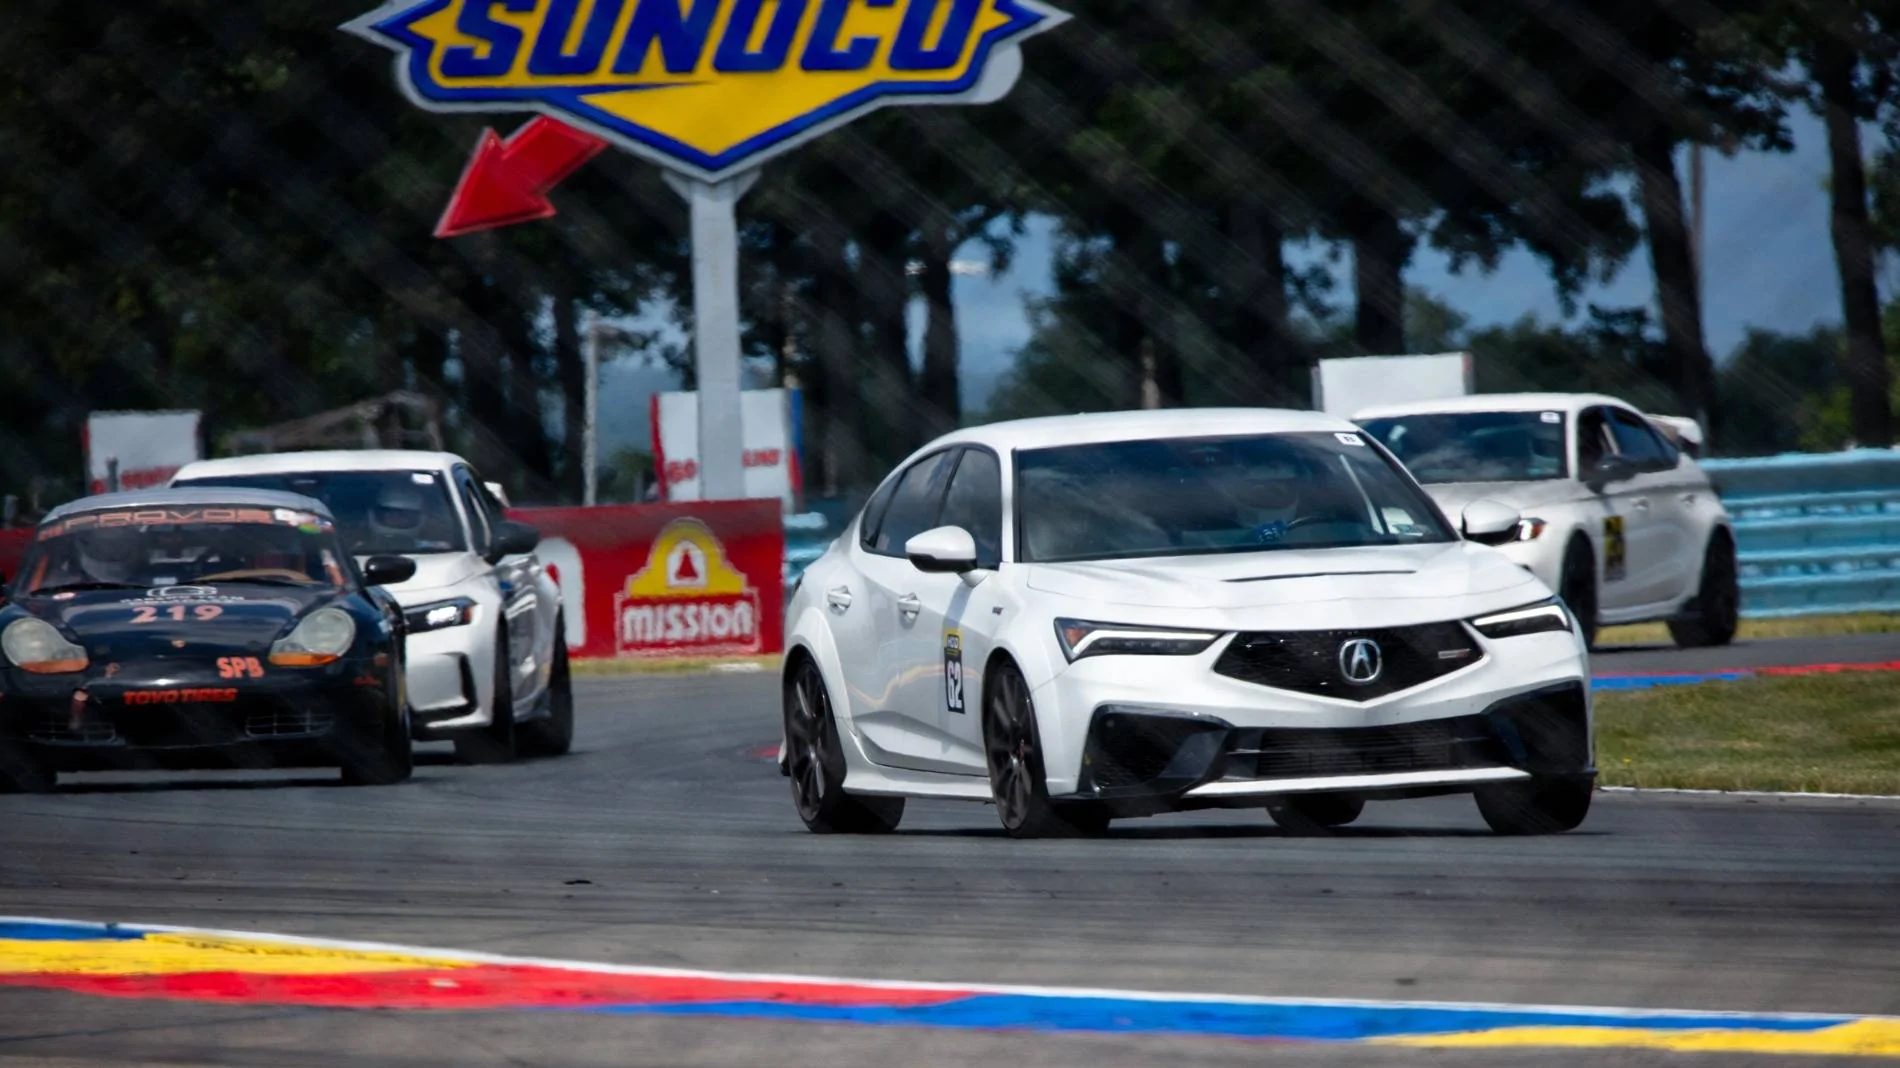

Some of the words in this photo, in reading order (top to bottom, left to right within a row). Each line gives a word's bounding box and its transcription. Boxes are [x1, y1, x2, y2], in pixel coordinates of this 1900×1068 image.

[440, 0, 978, 77] SUNOCO
[130, 605, 223, 624] 219
[216, 656, 265, 678] SPB
[947, 659, 963, 710] 62
